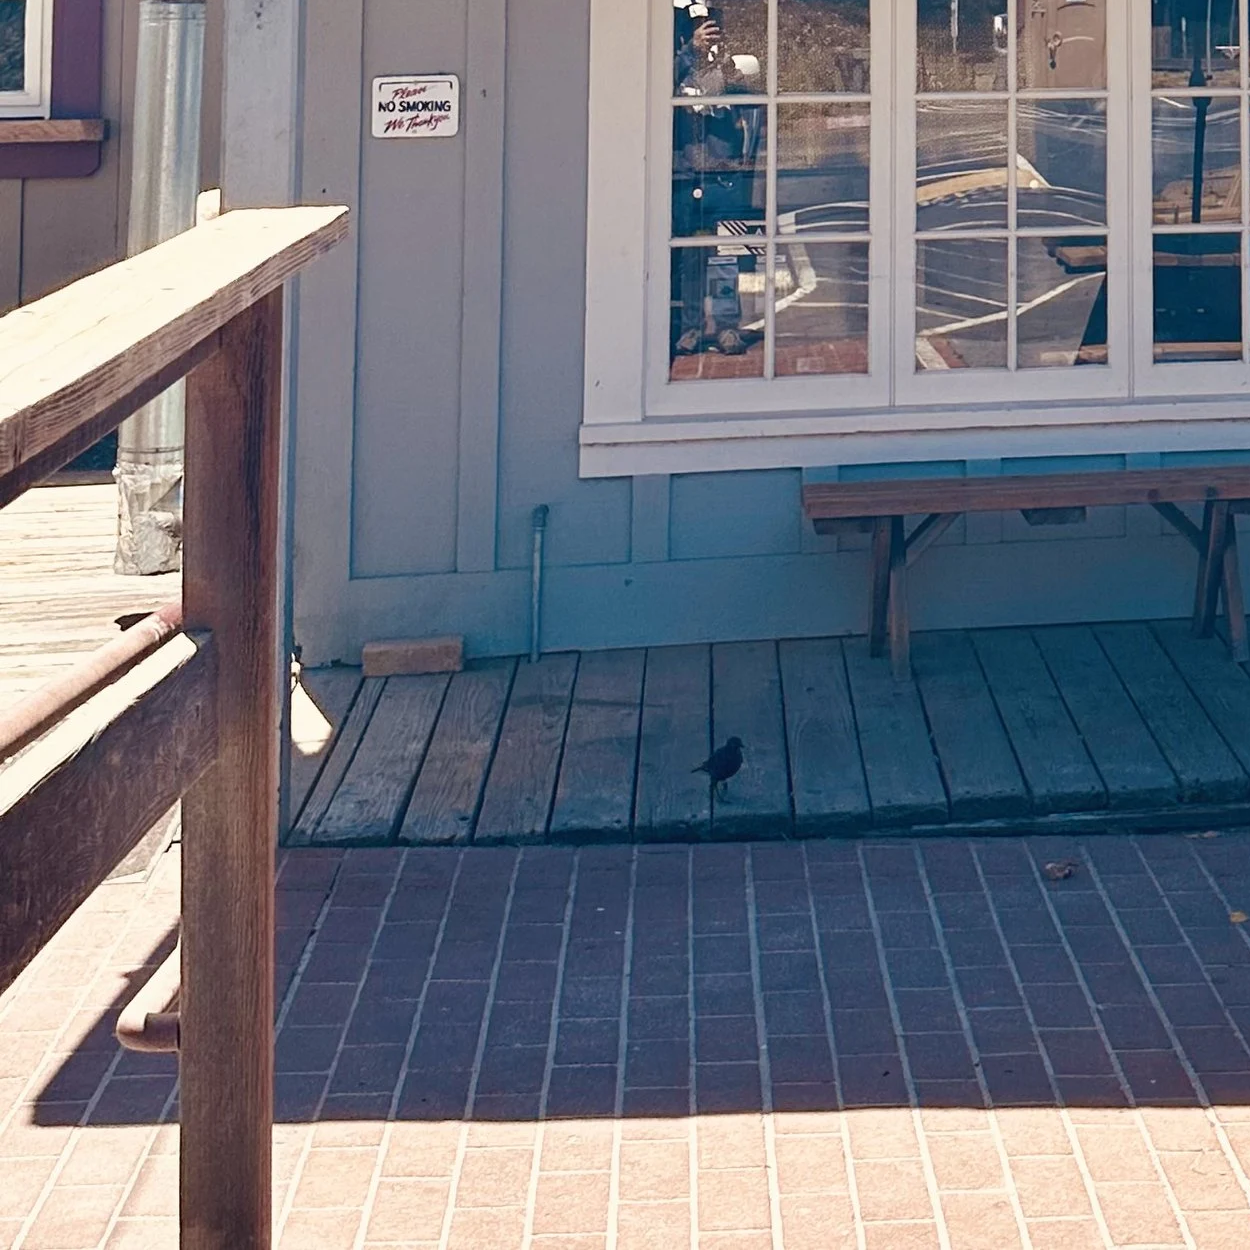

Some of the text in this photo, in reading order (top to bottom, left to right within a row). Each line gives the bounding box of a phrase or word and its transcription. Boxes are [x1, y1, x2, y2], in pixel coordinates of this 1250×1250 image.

[378, 100, 452, 112] NO SMOKING
[384, 118, 405, 133] We
